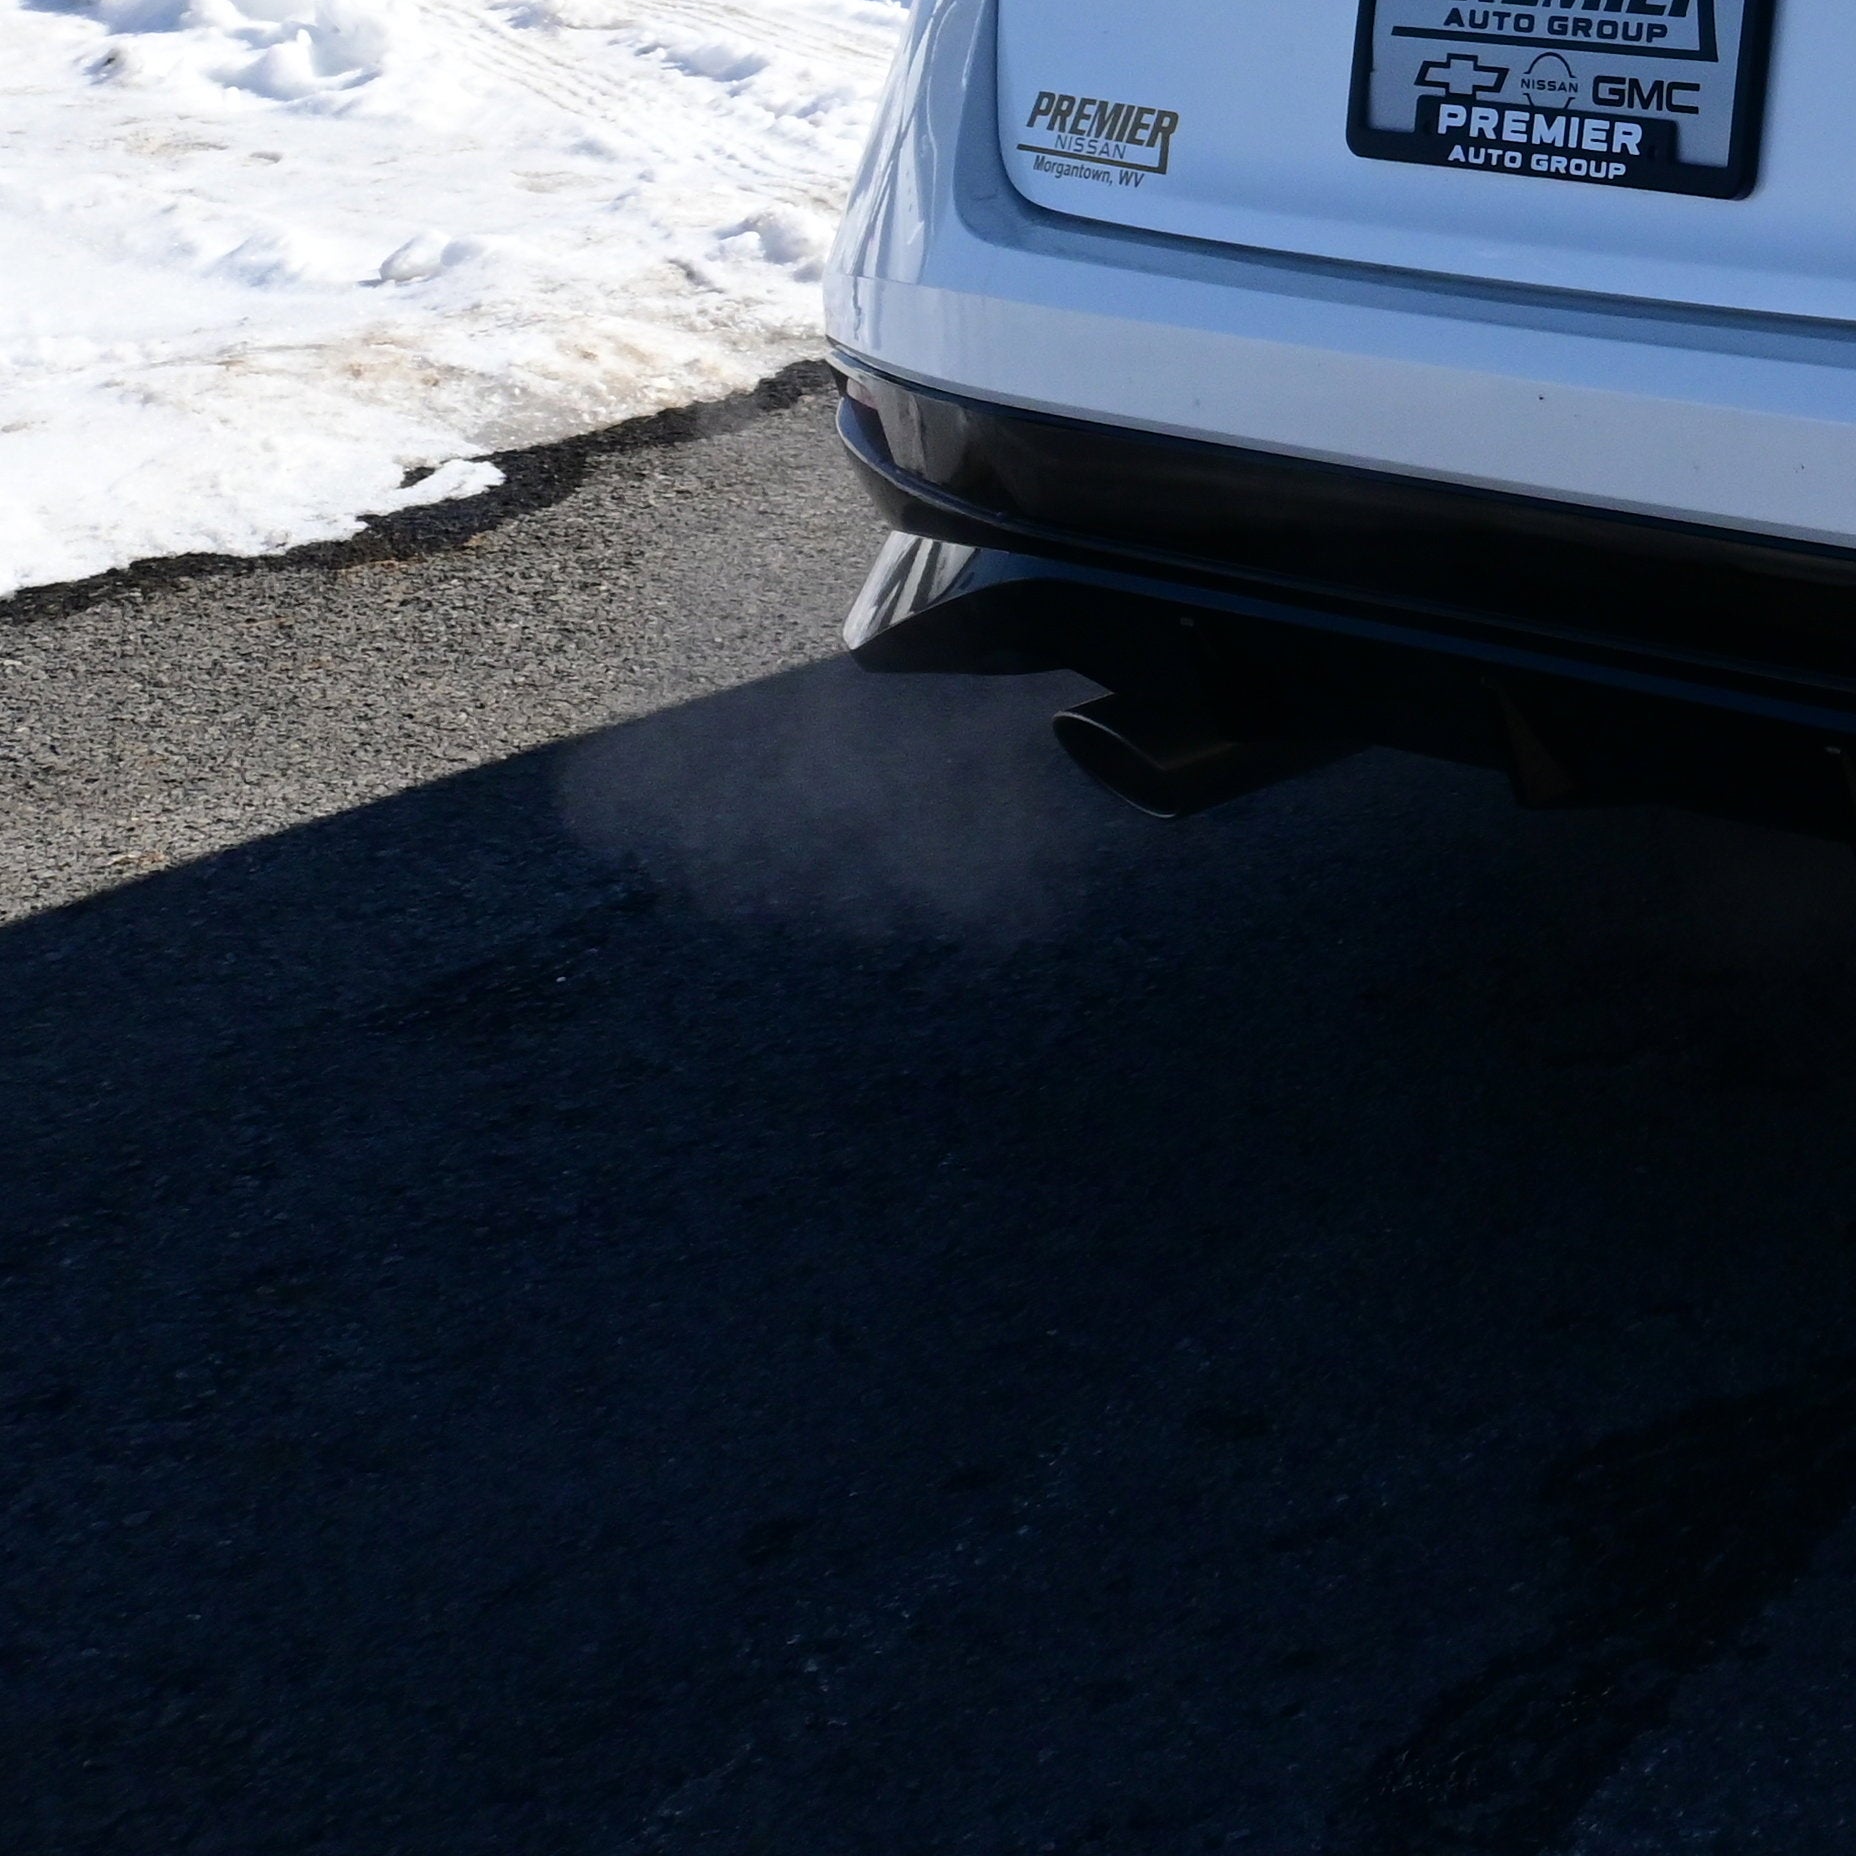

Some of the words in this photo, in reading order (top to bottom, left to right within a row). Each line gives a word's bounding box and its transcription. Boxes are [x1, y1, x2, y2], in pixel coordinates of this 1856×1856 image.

[1443, 7, 1535, 33] AUTO
[1547, 15, 1668, 43] GROUP
[1520, 78, 1578, 93] NISSAN
[1592, 75, 1701, 115] GMC
[1026, 90, 1179, 148] PREMIER
[1437, 103, 1643, 156] PREMIER
[1054, 134, 1127, 160] NISSAN
[1447, 144, 1522, 169] AUTO
[1530, 153, 1626, 180] GROUP
[1032, 154, 1114, 187] Morgantown,
[1118, 169, 1145, 188] WV
